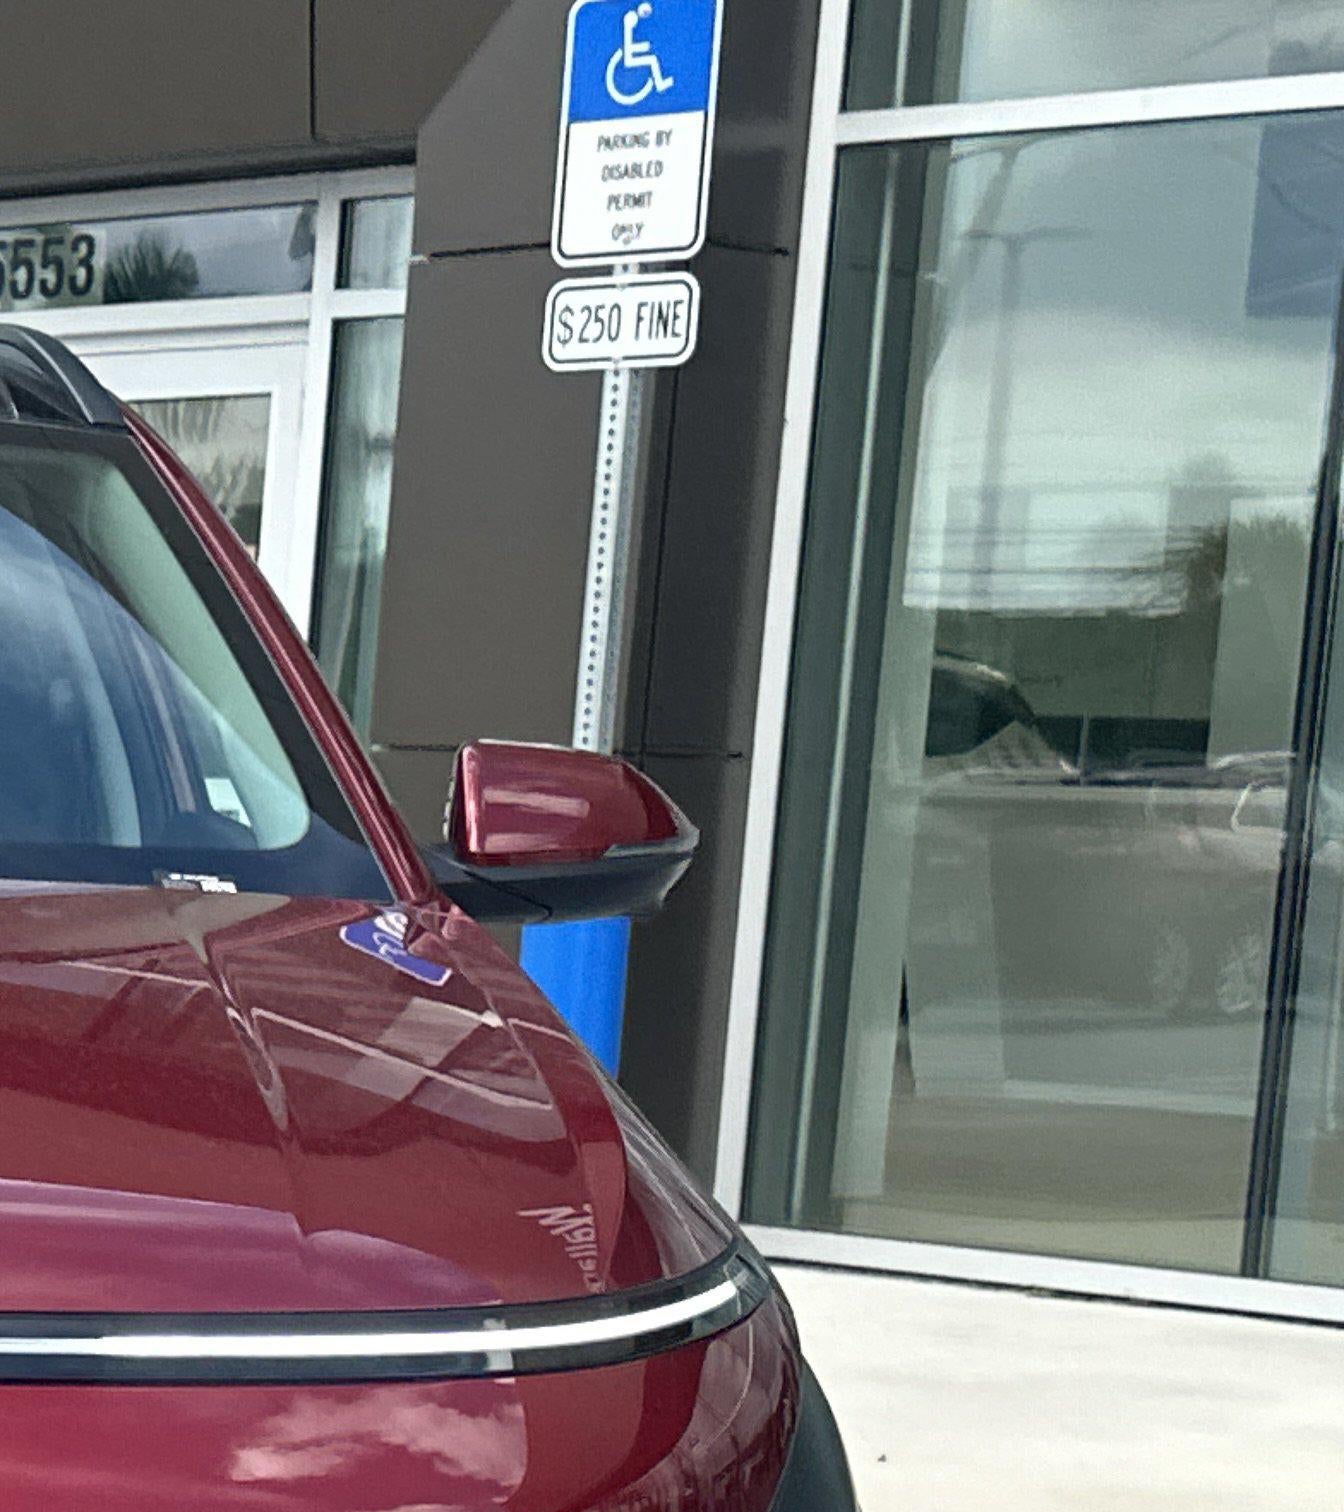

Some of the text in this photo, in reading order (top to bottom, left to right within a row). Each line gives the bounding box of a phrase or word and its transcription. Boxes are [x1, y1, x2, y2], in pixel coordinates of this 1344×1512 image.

[596, 128, 672, 152] PARKING BY
[601, 160, 664, 182] DISABLED
[607, 190, 653, 211] PERMIT
[557, 299, 684, 348] $250 FINE
